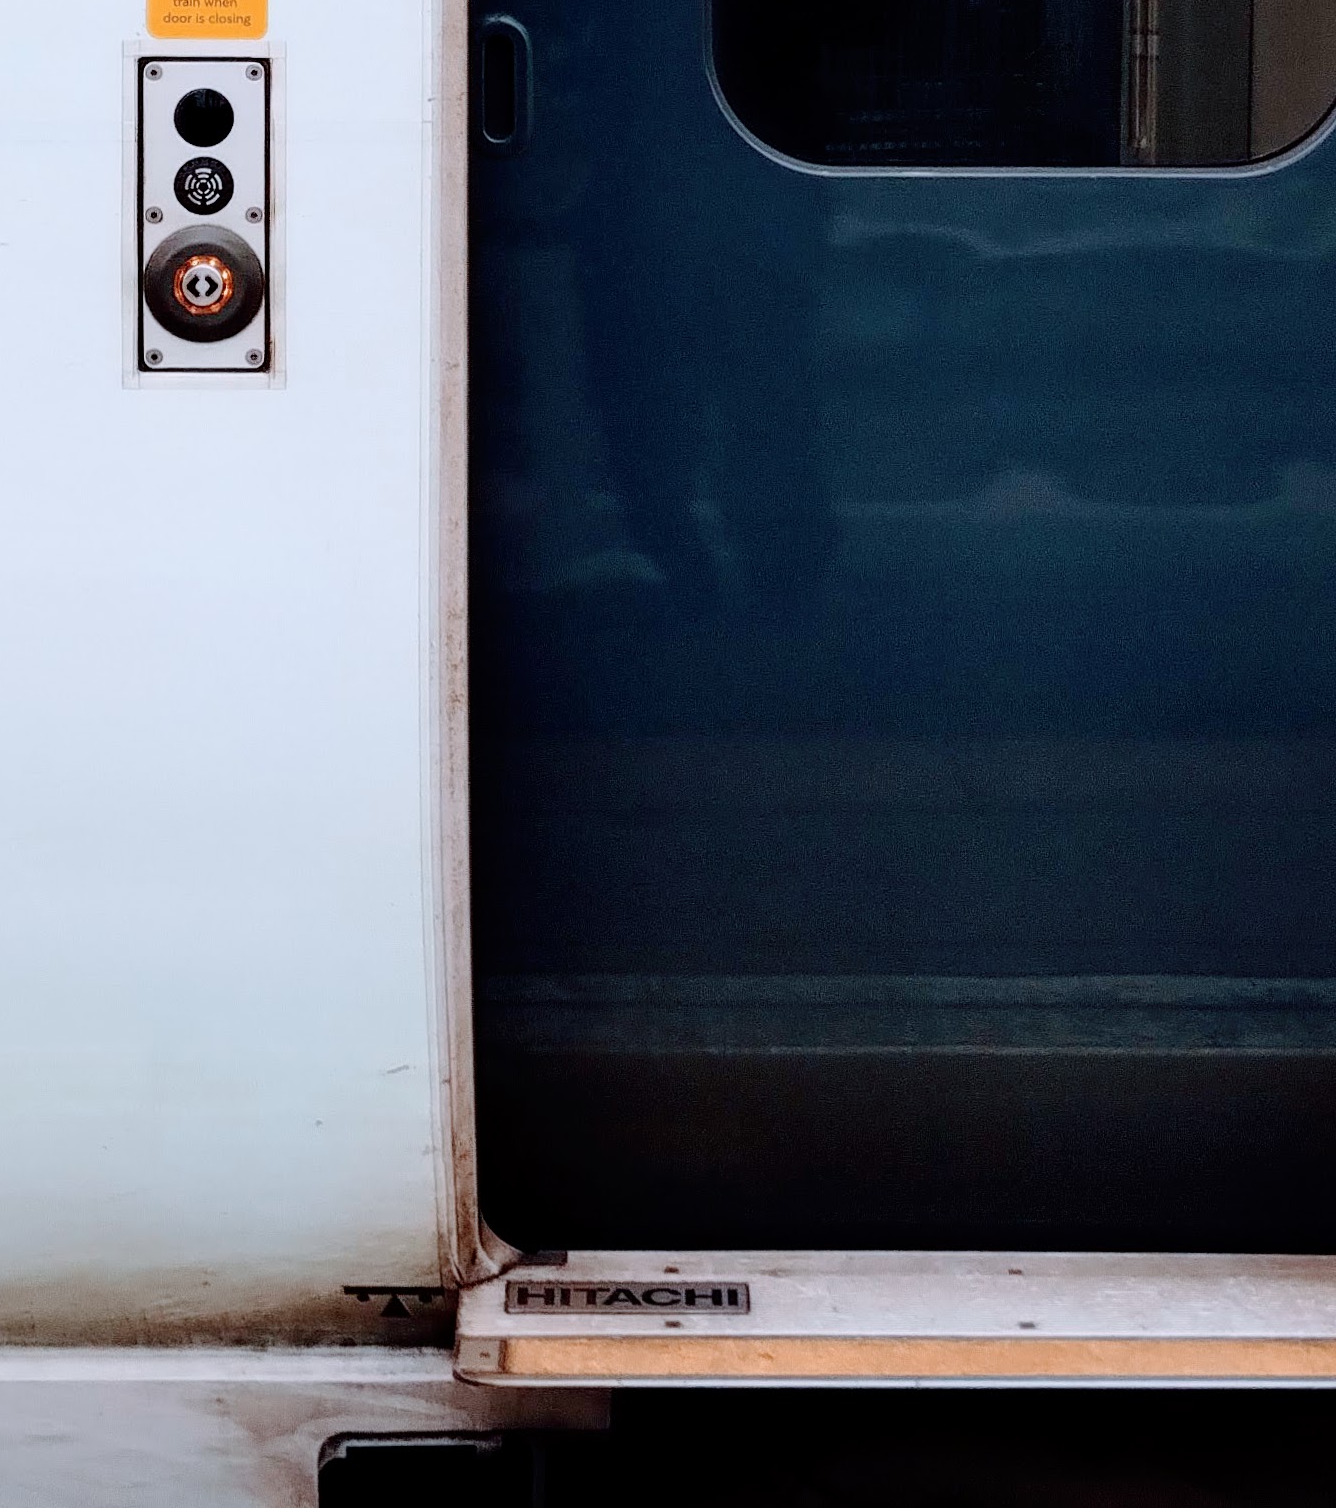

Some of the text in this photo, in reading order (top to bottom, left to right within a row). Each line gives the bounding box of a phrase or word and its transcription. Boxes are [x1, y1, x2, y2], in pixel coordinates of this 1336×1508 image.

[163, 11, 252, 27] door is closing
[516, 1286, 739, 1307] HITACHI
